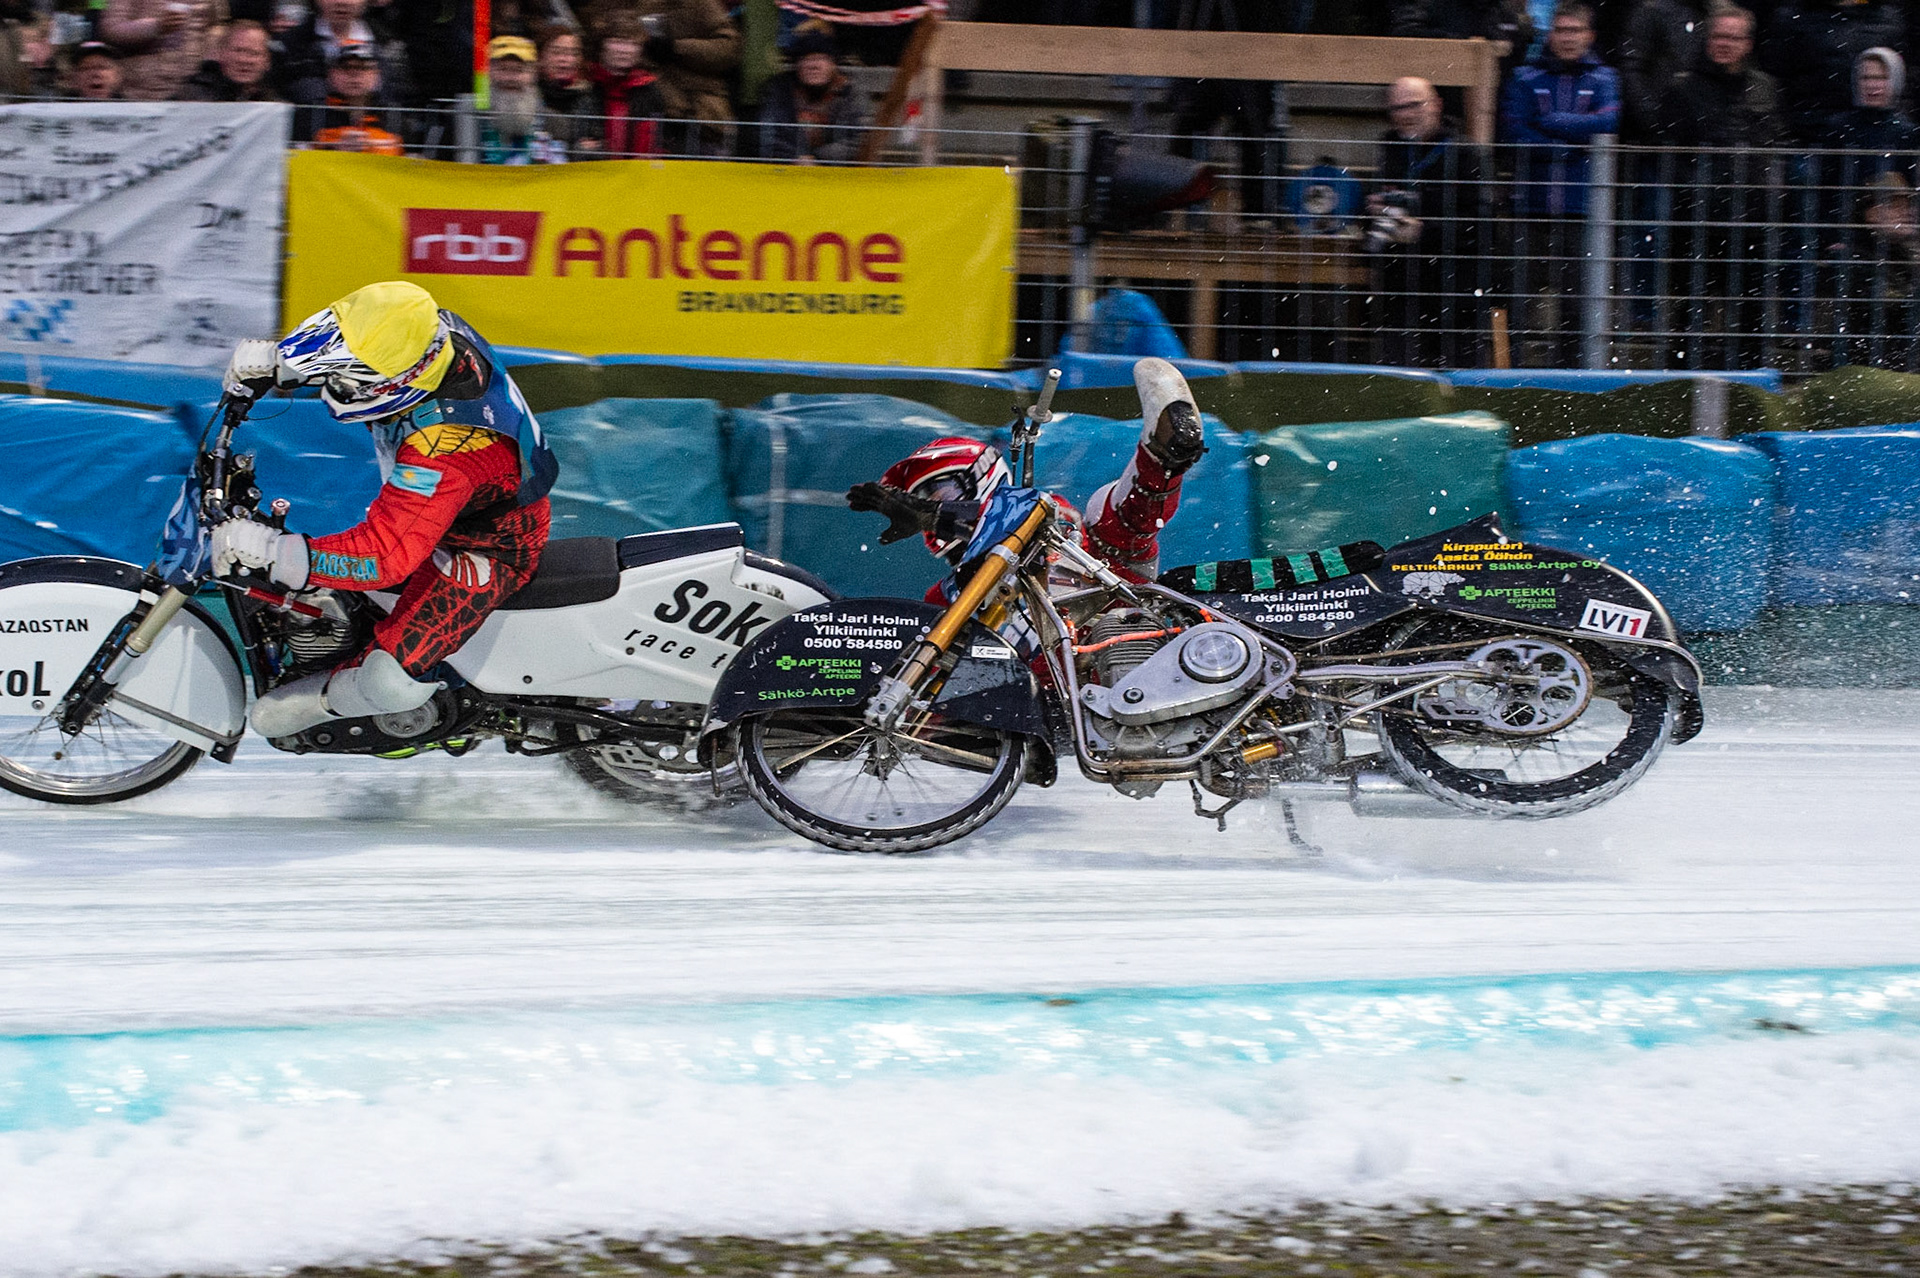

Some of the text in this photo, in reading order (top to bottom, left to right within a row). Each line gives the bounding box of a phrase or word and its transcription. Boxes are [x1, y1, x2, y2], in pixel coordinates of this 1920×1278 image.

[412, 223, 528, 263] rbb
[677, 290, 905, 315] BRANDENBURG
[1442, 542, 1523, 552] Kirpputori
[1433, 553, 1479, 562] Aasta
[1489, 560, 1600, 571] Sähkö-Artpe Oy
[1241, 586, 1370, 603] Taksi Jari Holmi
[1484, 588, 1555, 597] APTEEKKI
[1264, 600, 1348, 613] Ylikiiminki
[792, 613, 919, 626] Taksi Jari Holmi
[1255, 611, 1355, 622] 0500 584580
[814, 625, 897, 637] Ylikiiminki
[624, 628, 696, 660] race
[804, 638, 903, 650] 0500 584580
[758, 686, 856, 701] Sähkö-Artpe
